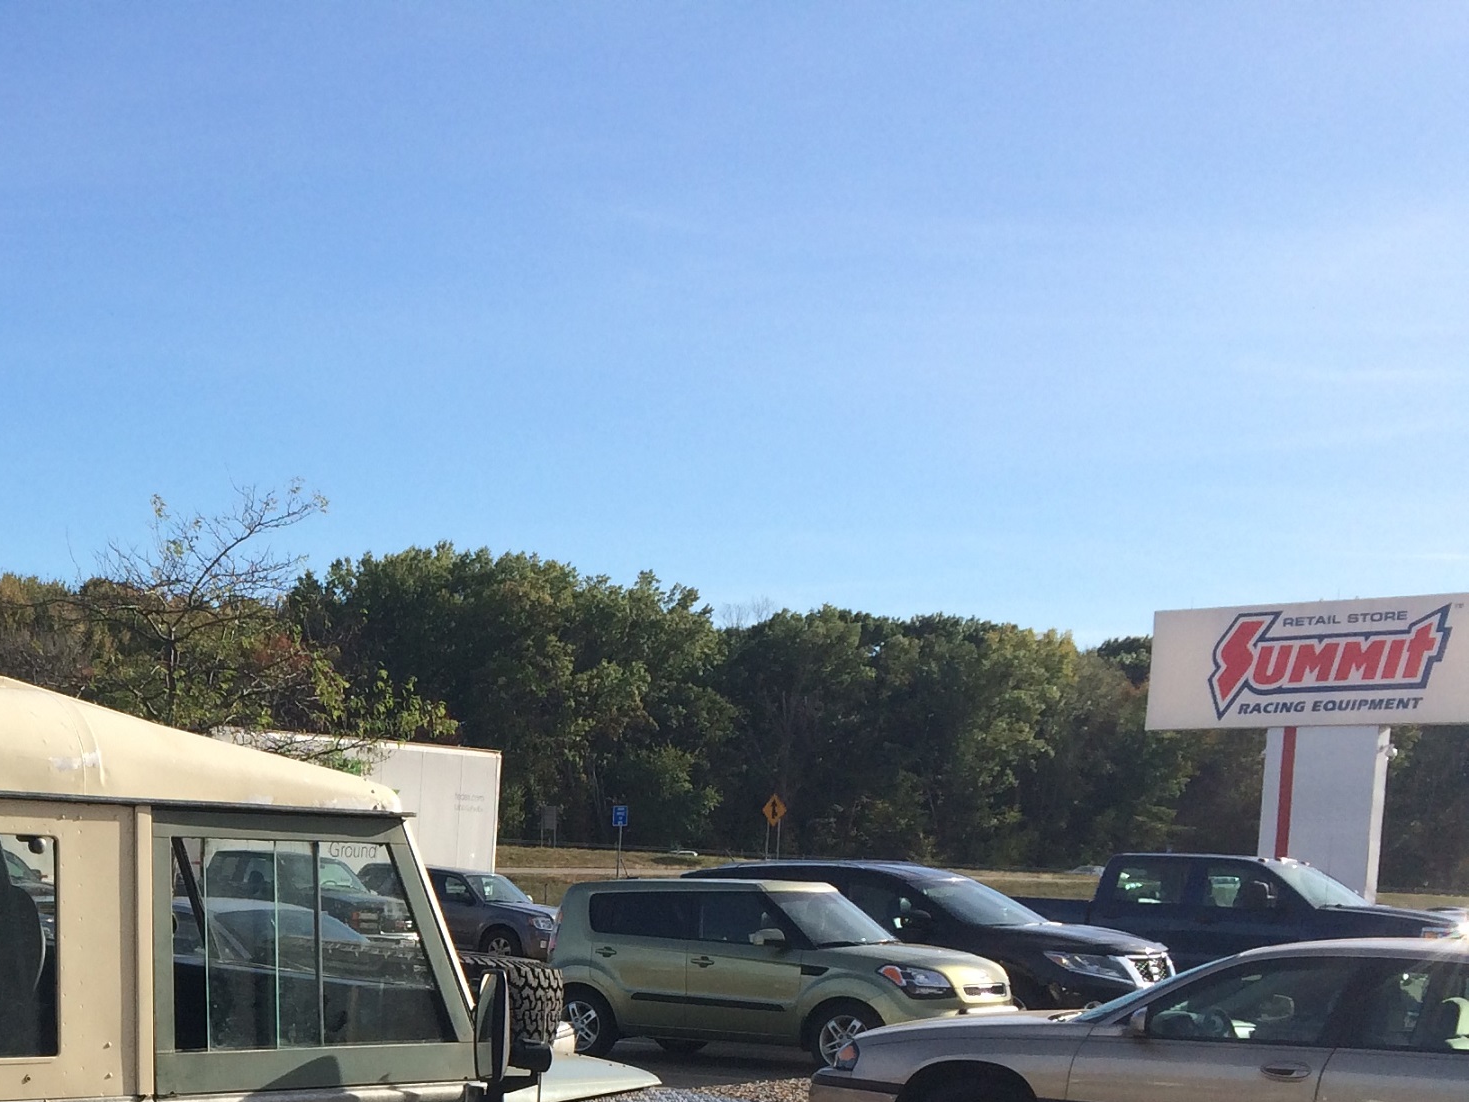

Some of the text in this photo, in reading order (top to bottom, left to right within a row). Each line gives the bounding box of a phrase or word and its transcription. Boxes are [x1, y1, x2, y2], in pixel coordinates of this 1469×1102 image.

[1282, 610, 1408, 628] RETAIL STORE
[1237, 696, 1424, 715] RACING EQUIPMENT
[329, 841, 378, 859] Ground
